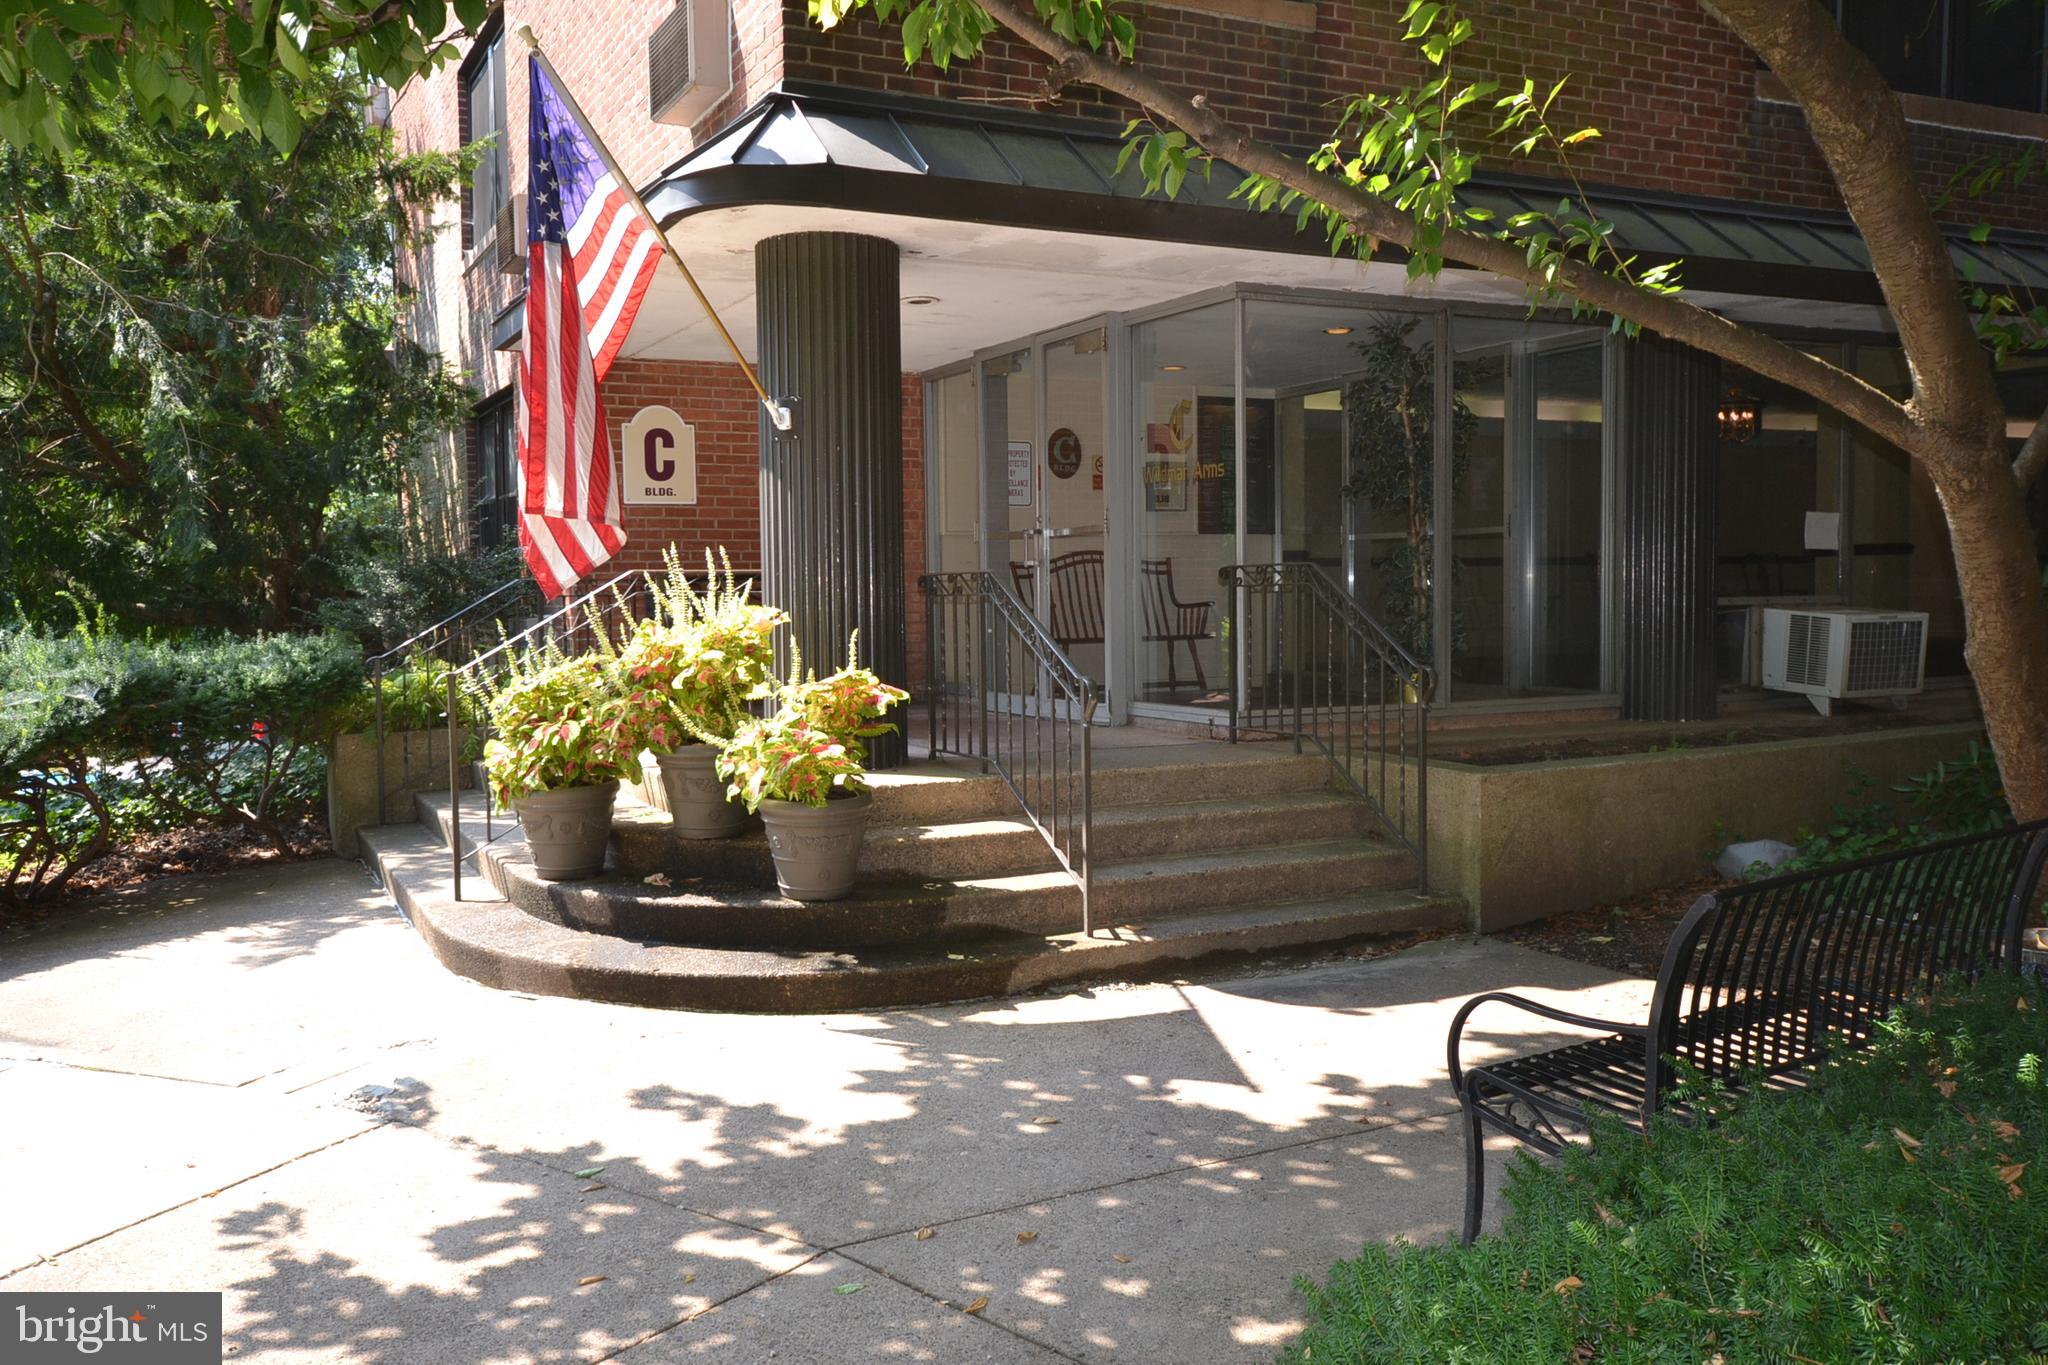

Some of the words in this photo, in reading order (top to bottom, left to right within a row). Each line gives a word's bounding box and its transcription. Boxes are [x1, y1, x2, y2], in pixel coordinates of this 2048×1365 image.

[644, 428, 675, 482] C
[1054, 435, 1077, 464] C
[1194, 461, 1225, 481] Arms
[645, 487, 677, 496] BLDG.
